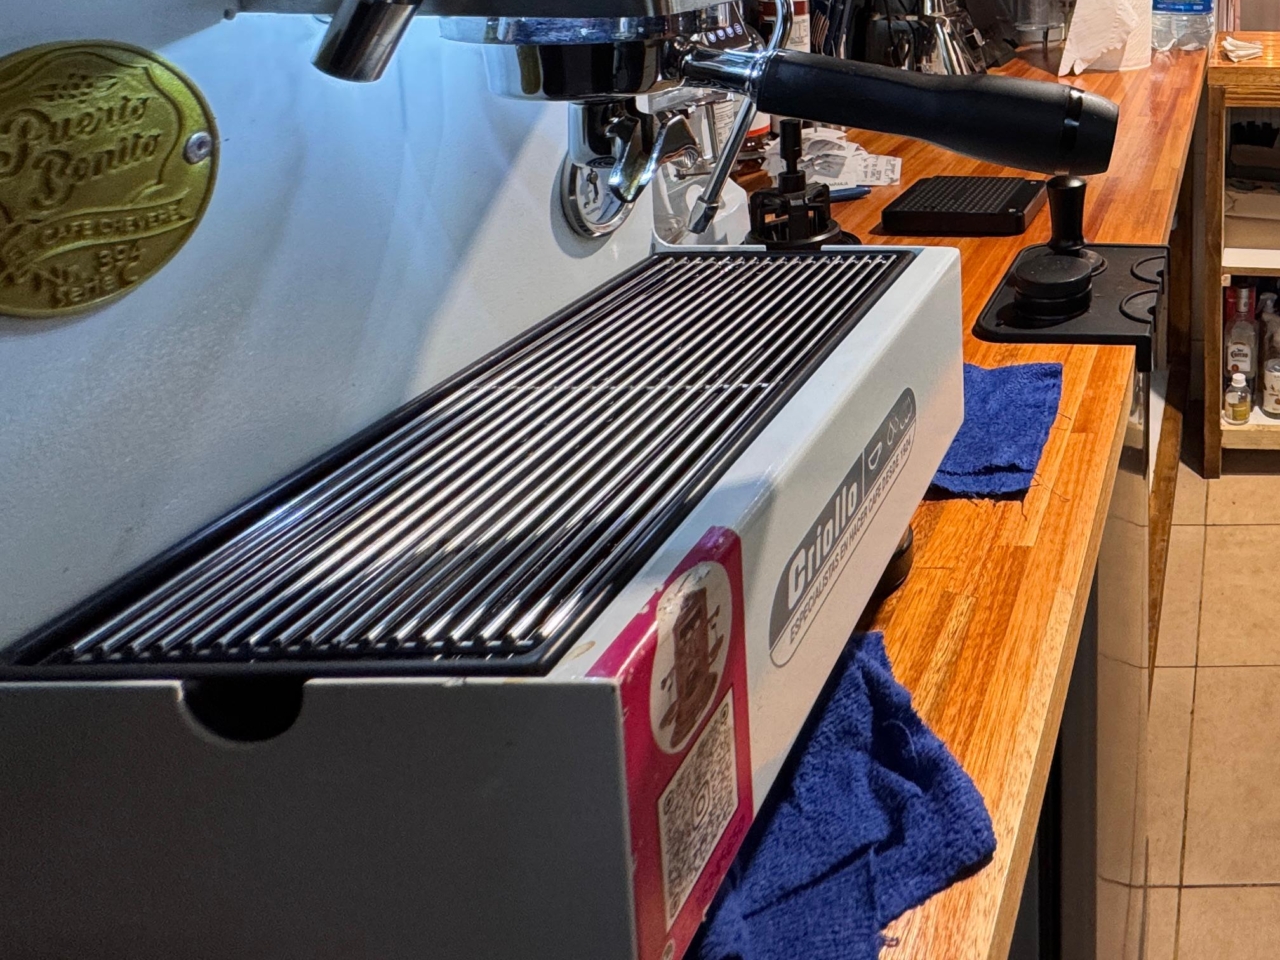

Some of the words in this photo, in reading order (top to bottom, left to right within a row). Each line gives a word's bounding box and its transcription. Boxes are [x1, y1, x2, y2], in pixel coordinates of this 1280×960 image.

[788, 482, 858, 611] Criollo
[789, 552, 840, 646] ESPECIALISTAS
[839, 537, 849, 561] EN
[848, 505, 868, 548] HACER
[868, 482, 881, 514] CAFE
[881, 453, 900, 492] DESDE
